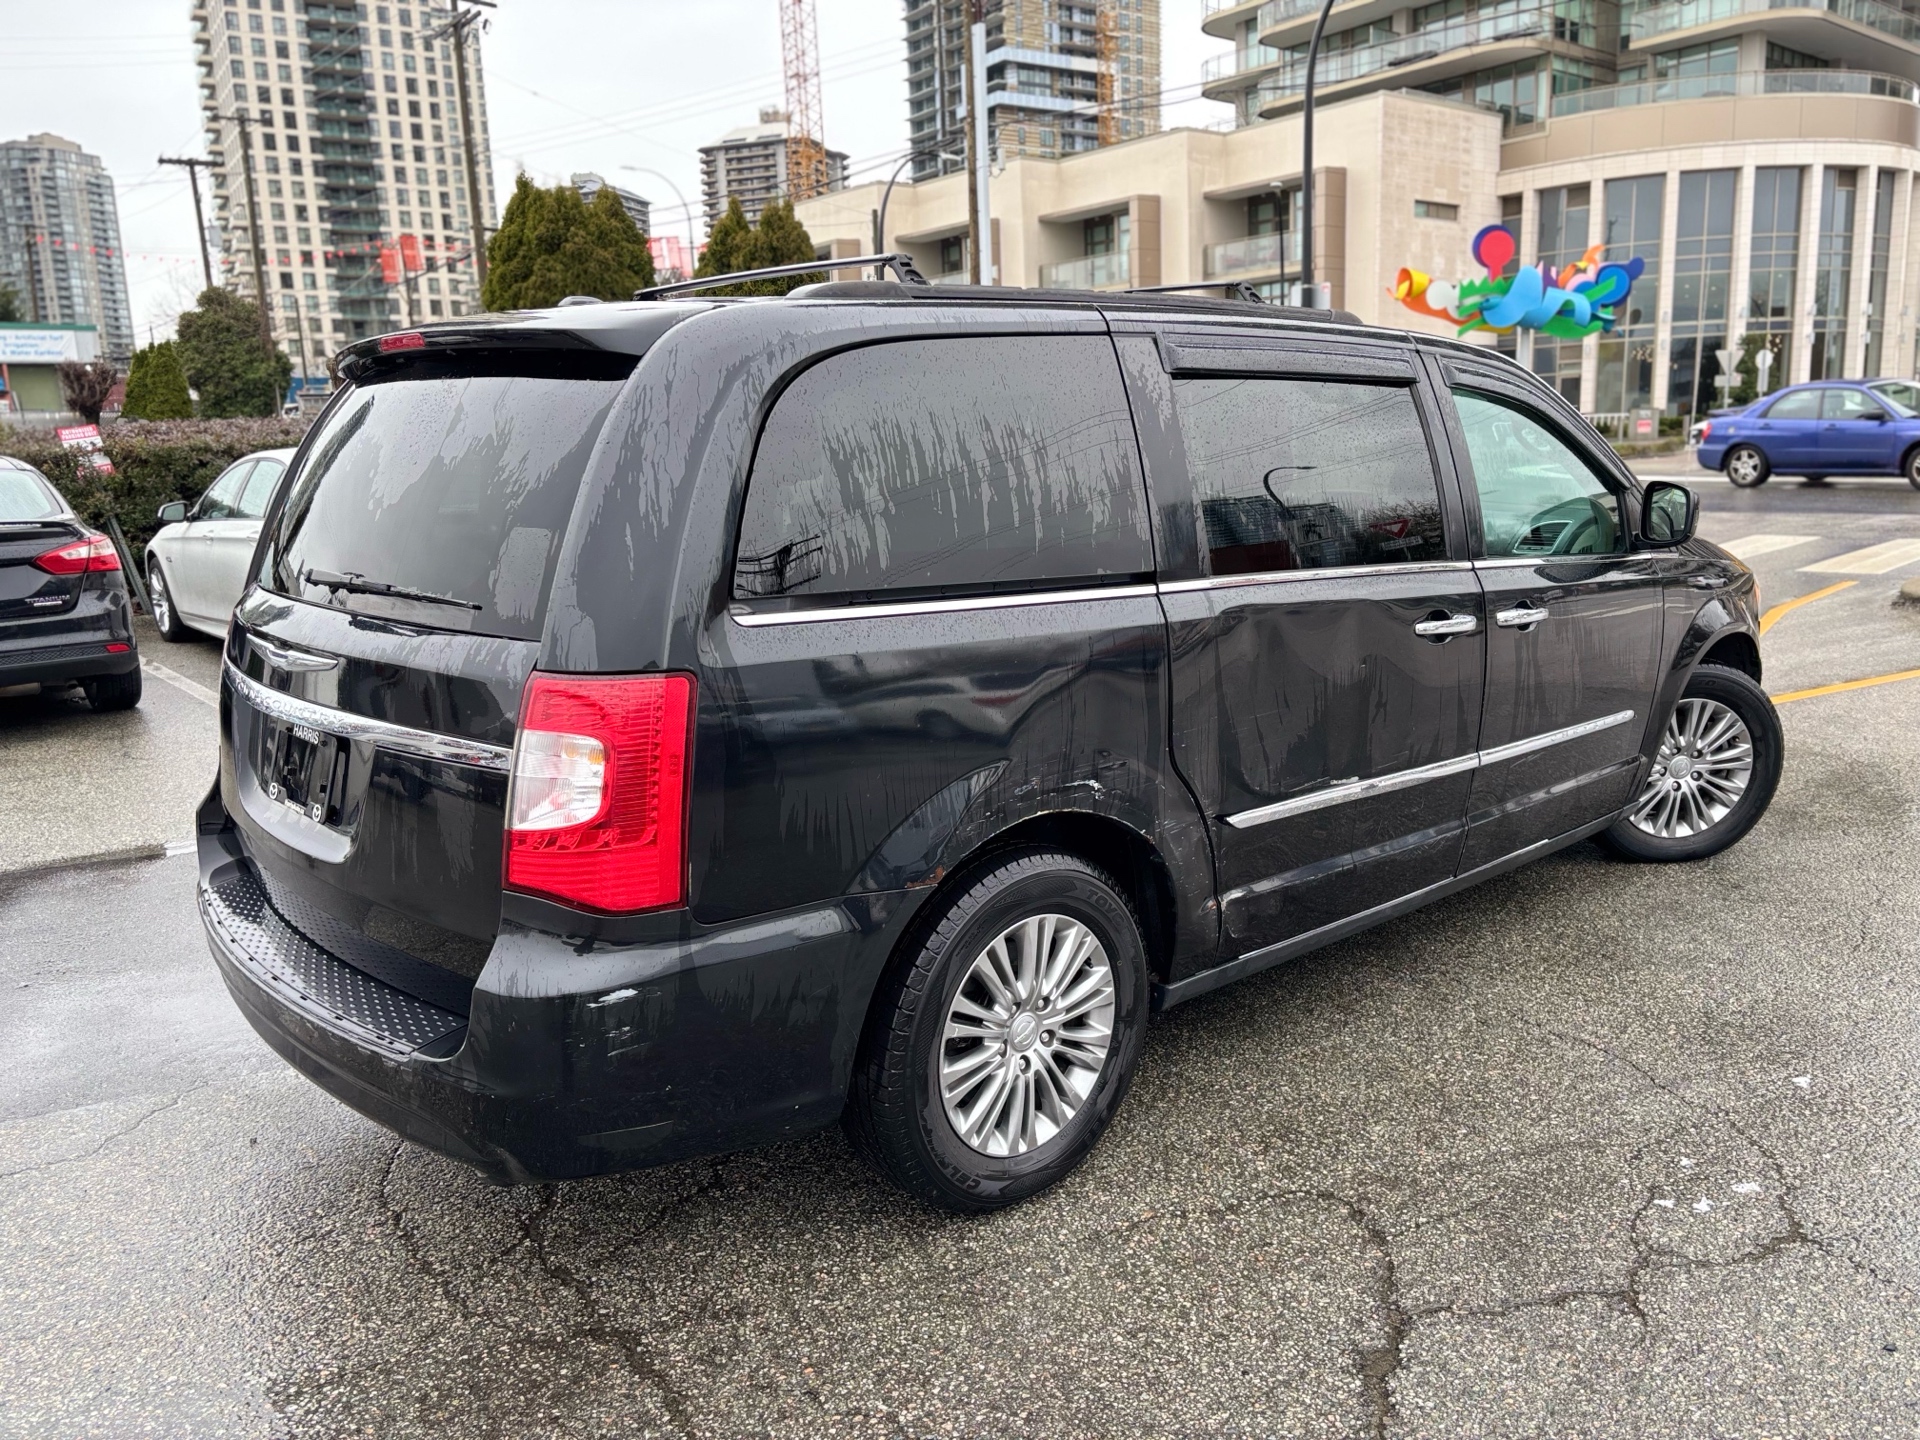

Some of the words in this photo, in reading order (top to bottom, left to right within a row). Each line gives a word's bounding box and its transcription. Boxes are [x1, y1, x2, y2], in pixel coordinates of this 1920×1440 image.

[61, 426, 93, 435] AUTHORIZED
[61, 432, 85, 440] PARKING
[24, 594, 71, 604] TITANIUM
[235, 678, 257, 700] TOWN
[263, 696, 345, 726] COUNTRY
[293, 723, 320, 745] HARRIS
[1086, 888, 1125, 927] TOYO
